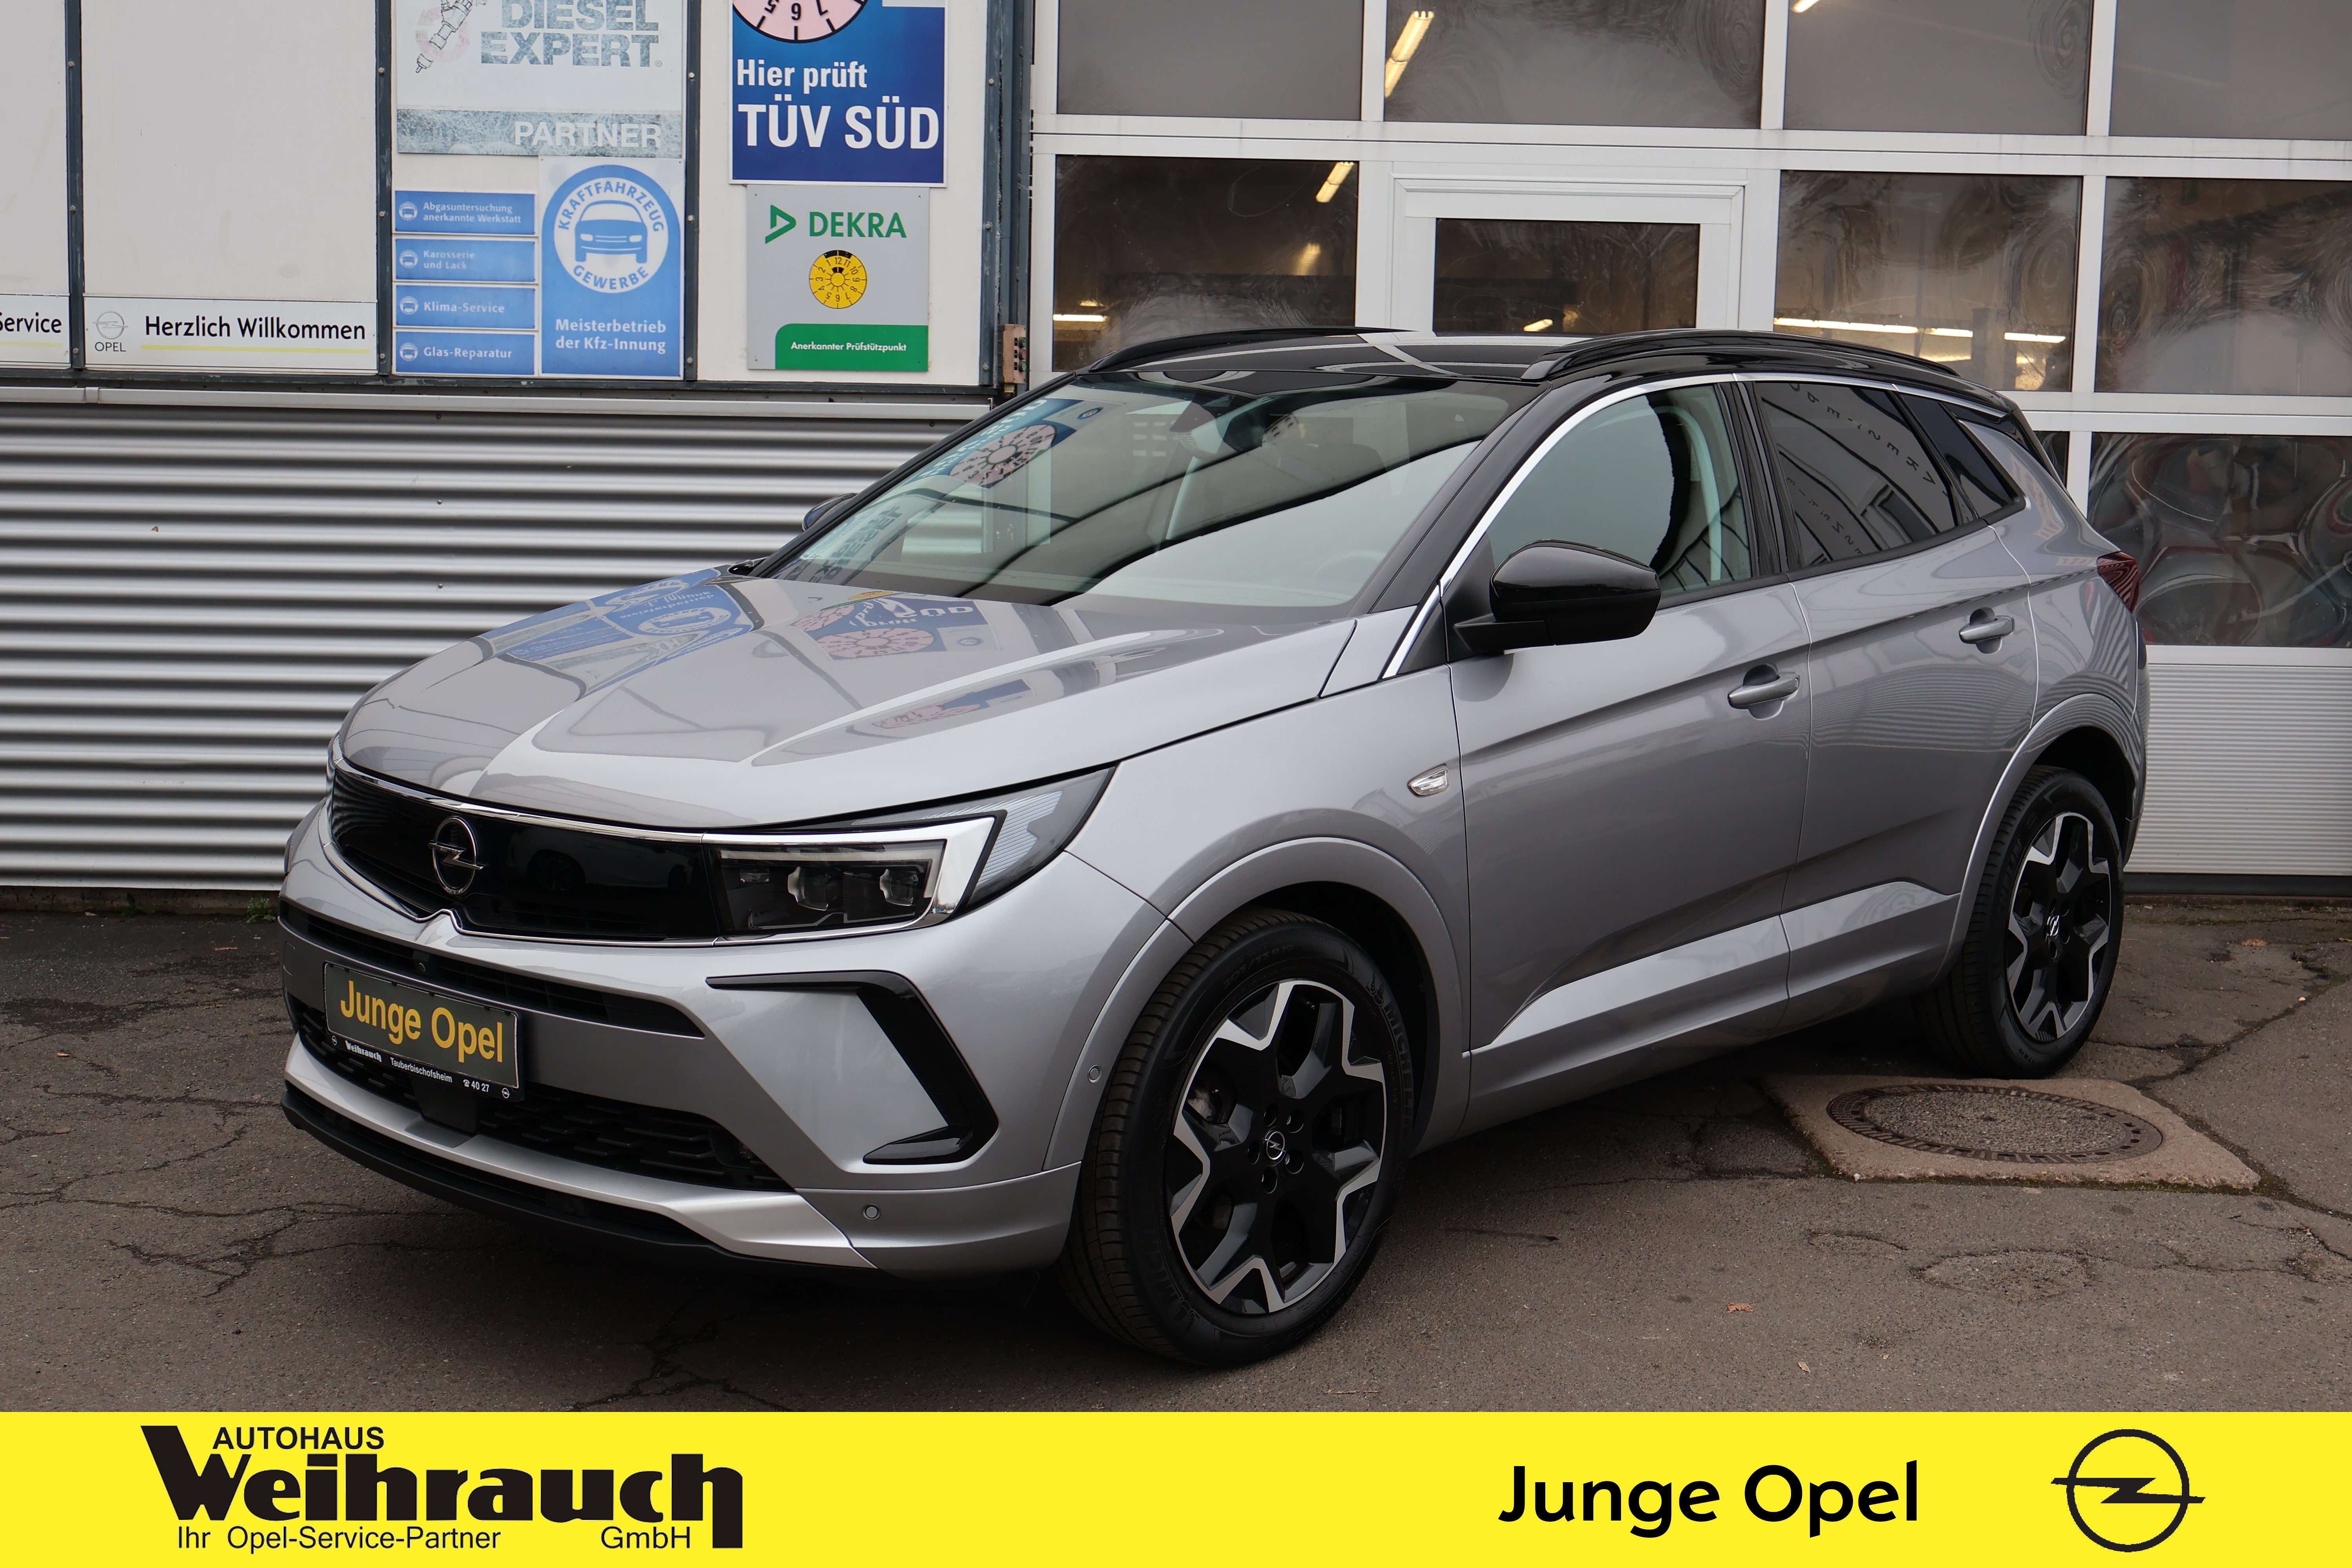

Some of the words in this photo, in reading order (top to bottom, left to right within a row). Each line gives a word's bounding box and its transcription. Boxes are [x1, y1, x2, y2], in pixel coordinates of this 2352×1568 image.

[502, 0, 659, 31] DIESEL
[737, 59, 795, 86] Hier
[803, 61, 867, 94] prüft
[738, 94, 831, 147] TÜV
[845, 96, 939, 149] SÜD
[514, 122, 661, 148] PARTNER
[423, 202, 512, 214] Abgasuntersuchung
[423, 214, 475, 222] anerkannte
[477, 215, 521, 223] Werkstatt
[557, 181, 664, 232] KRAFTFAHRZEUG
[809, 211, 907, 238] DEKRA
[423, 250, 475, 259] Karosserie
[573, 265, 649, 290] GEWERBE
[424, 301, 505, 313] Klima-Service
[145, 315, 230, 337] Herzlich
[237, 318, 366, 340] Willkommen
[555, 319, 666, 333] Meisterbetrieb
[94, 342, 126, 352] OPEL
[423, 347, 512, 360] Glas-Reparatur
[555, 336, 579, 349] der
[584, 337, 666, 354] Kfz-Innung
[791, 341, 844, 350] Anerkannter
[846, 342, 907, 353] Prüfstützpunkt
[340, 980, 421, 1045] Junge
[432, 1007, 503, 1063] Opel
[345, 1040, 382, 1062] Weihrauch
[390, 1057, 453, 1083] Tauberbischofsheim
[481, 1084, 489, 1093] 27
